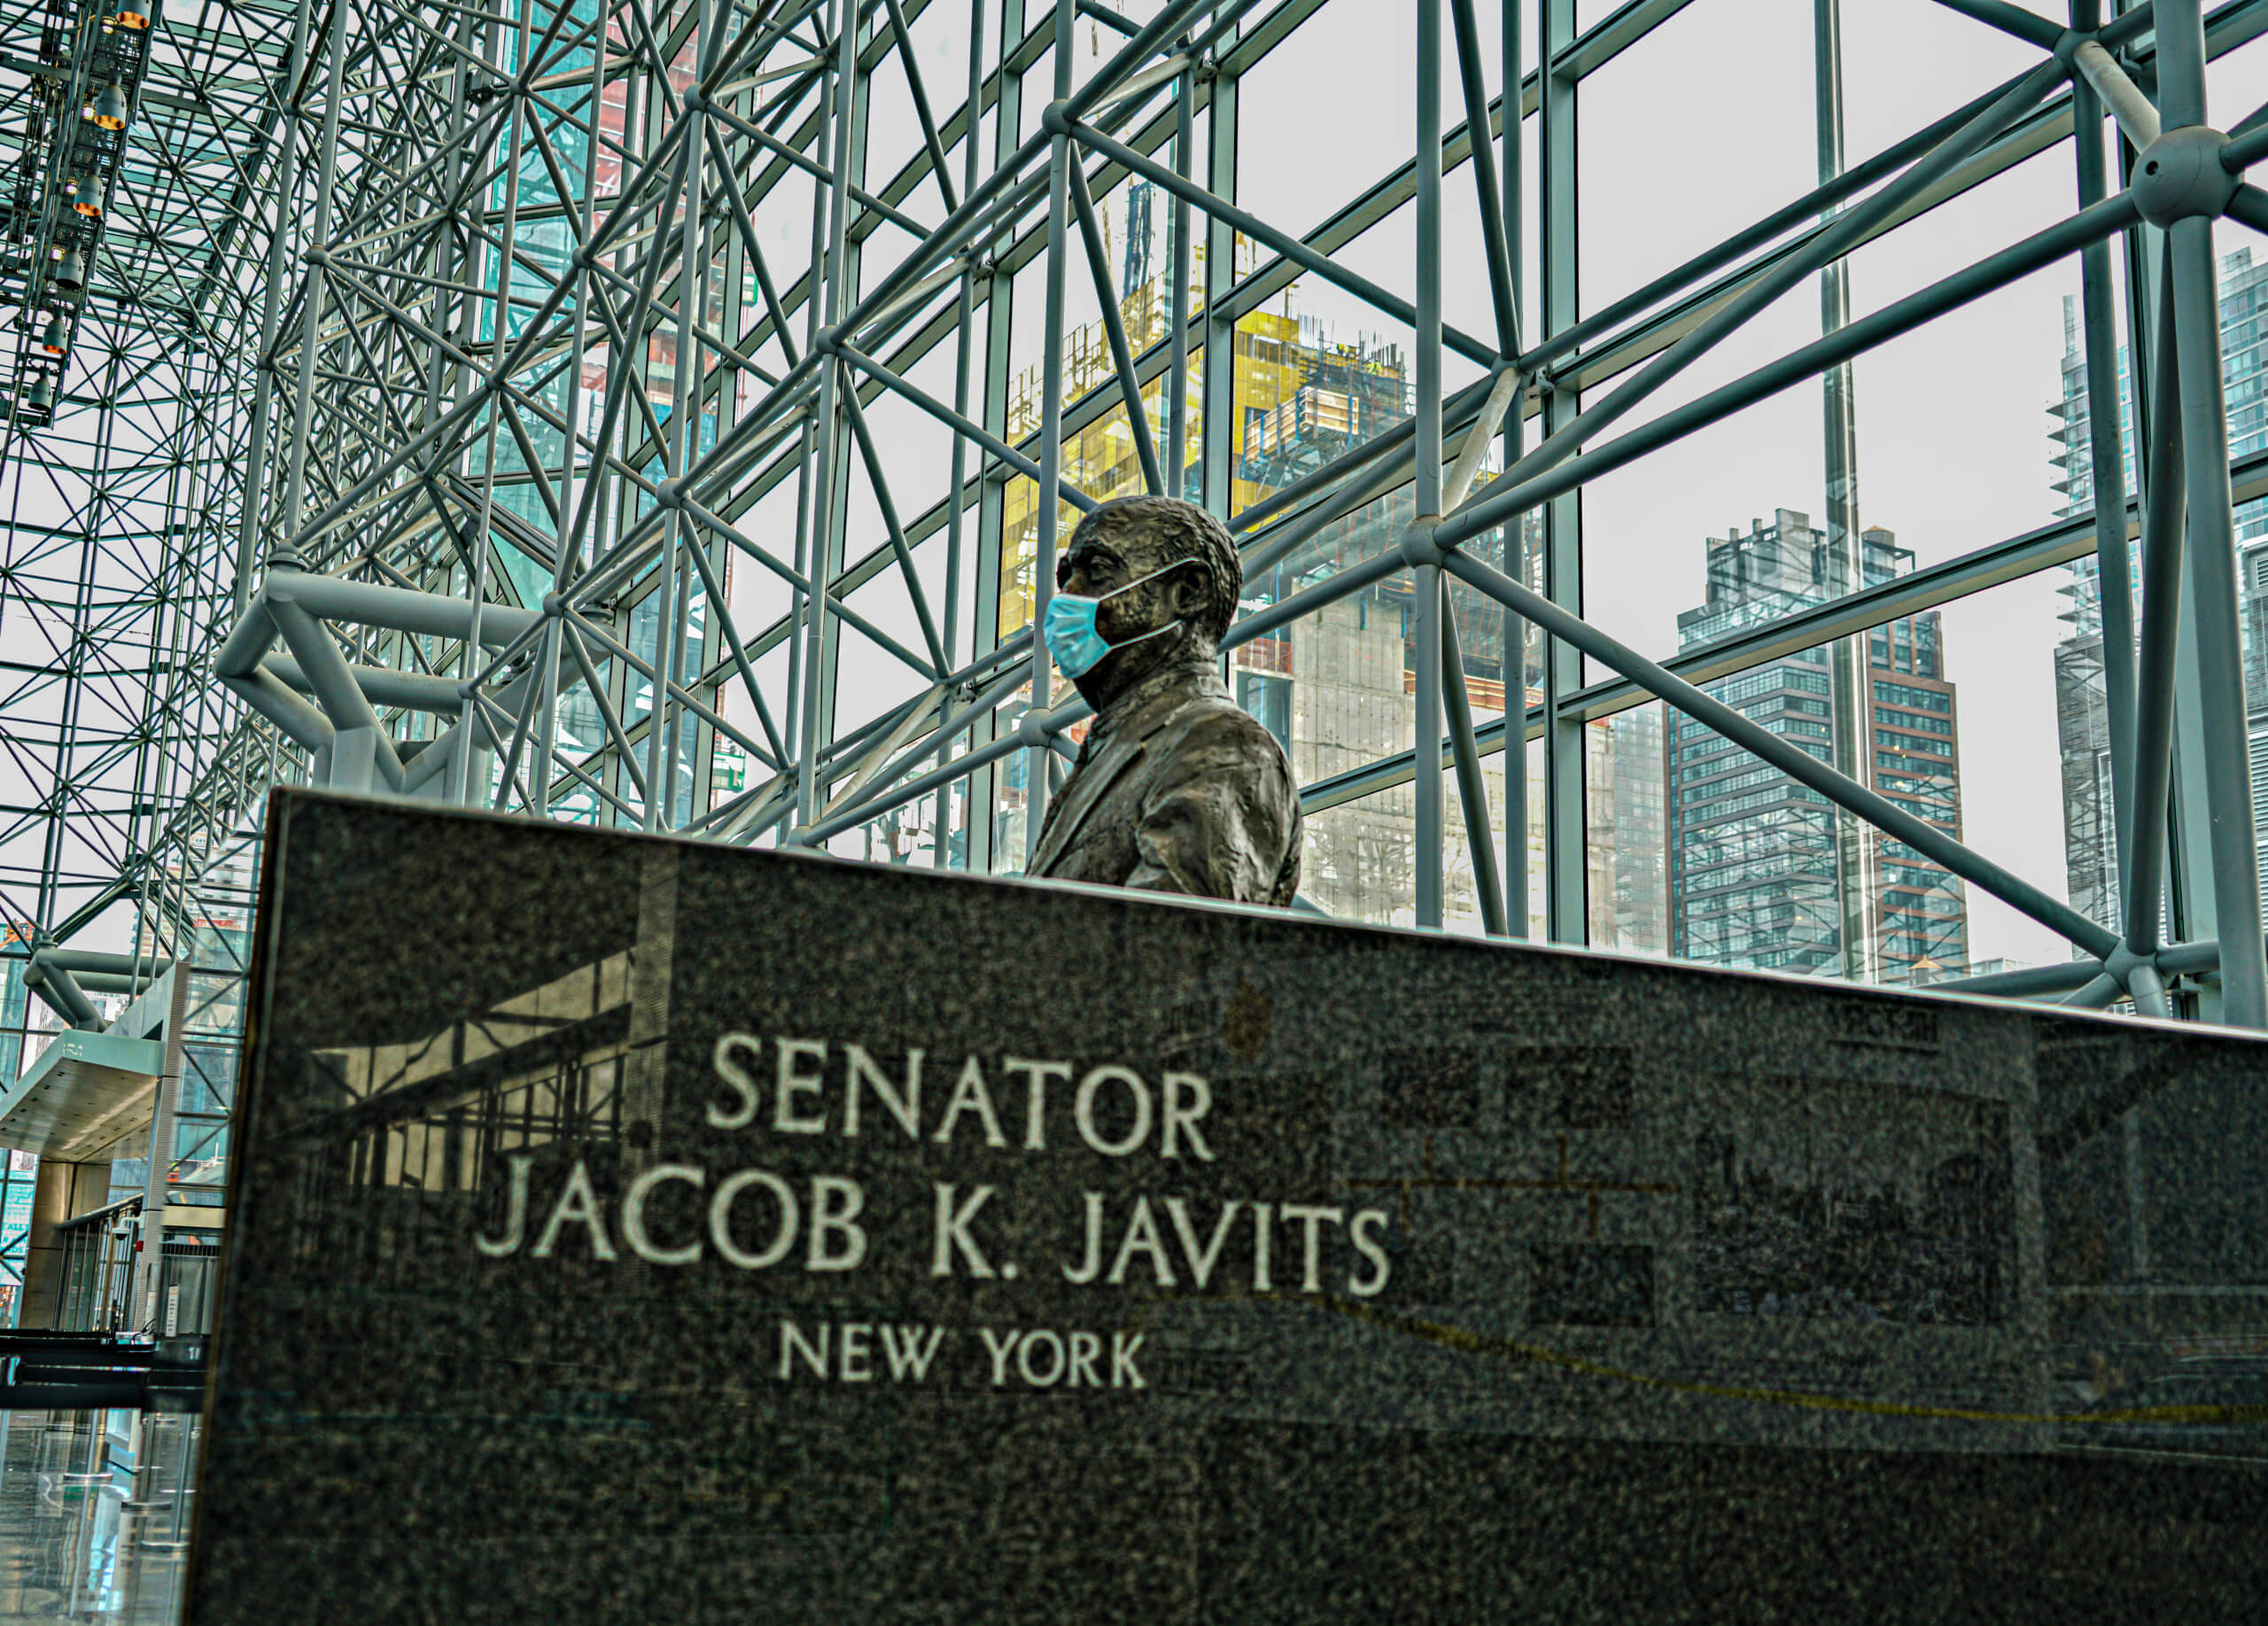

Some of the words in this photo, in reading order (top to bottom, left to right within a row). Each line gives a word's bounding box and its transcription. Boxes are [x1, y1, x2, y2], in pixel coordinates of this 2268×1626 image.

[708, 1032, 1215, 1162] SENATOR
[476, 1154, 866, 1271] JACOB
[931, 1181, 1021, 1280] K.
[1062, 1192, 1391, 1297] JAVITS
[779, 1320, 945, 1381] NEW
[979, 1326, 1146, 1390] YORK
